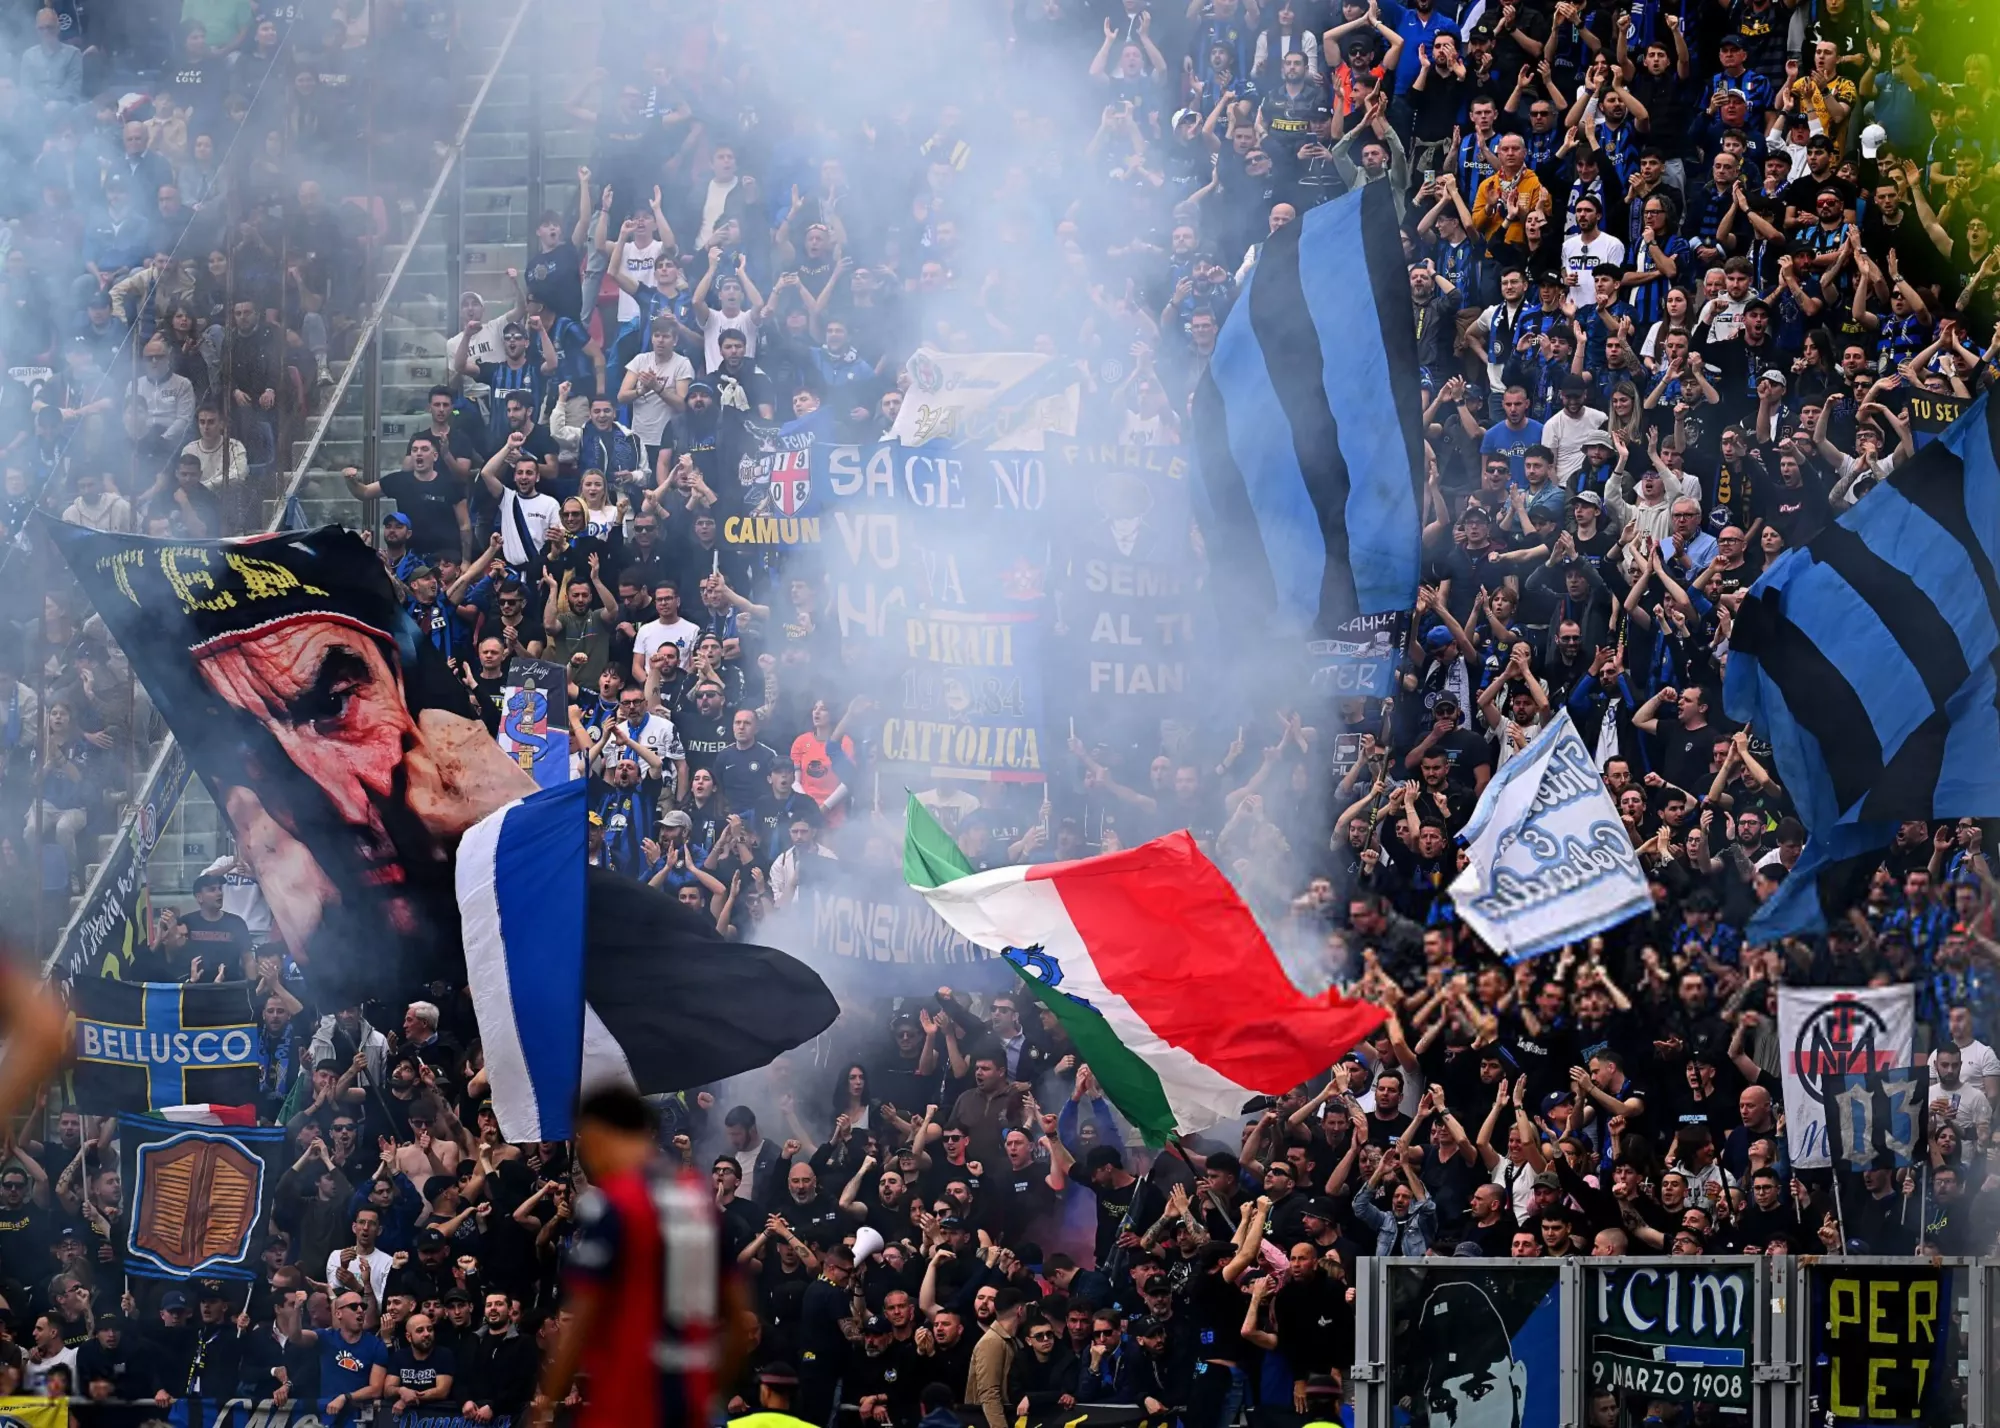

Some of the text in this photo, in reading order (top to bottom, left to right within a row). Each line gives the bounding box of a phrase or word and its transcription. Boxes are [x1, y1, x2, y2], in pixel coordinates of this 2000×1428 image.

[175, 76, 201, 84] LOVE
[1912, 398, 1930, 419] TU
[829, 446, 895, 498] SA
[1062, 445, 1188, 480] FINALE
[906, 618, 1013, 667] PIRATI
[1091, 612, 1144, 646] AL
[522, 662, 550, 680] Luigi
[688, 740, 727, 752] INTER
[882, 718, 1041, 769] CATTOLICA
[188, 845, 199, 854] 12
[84, 1024, 252, 1064] BELLUSCO
[1829, 1278, 1938, 1344] PER
[1592, 1361, 1604, 1385] 9
[1692, 1373, 1742, 1399] 1908
